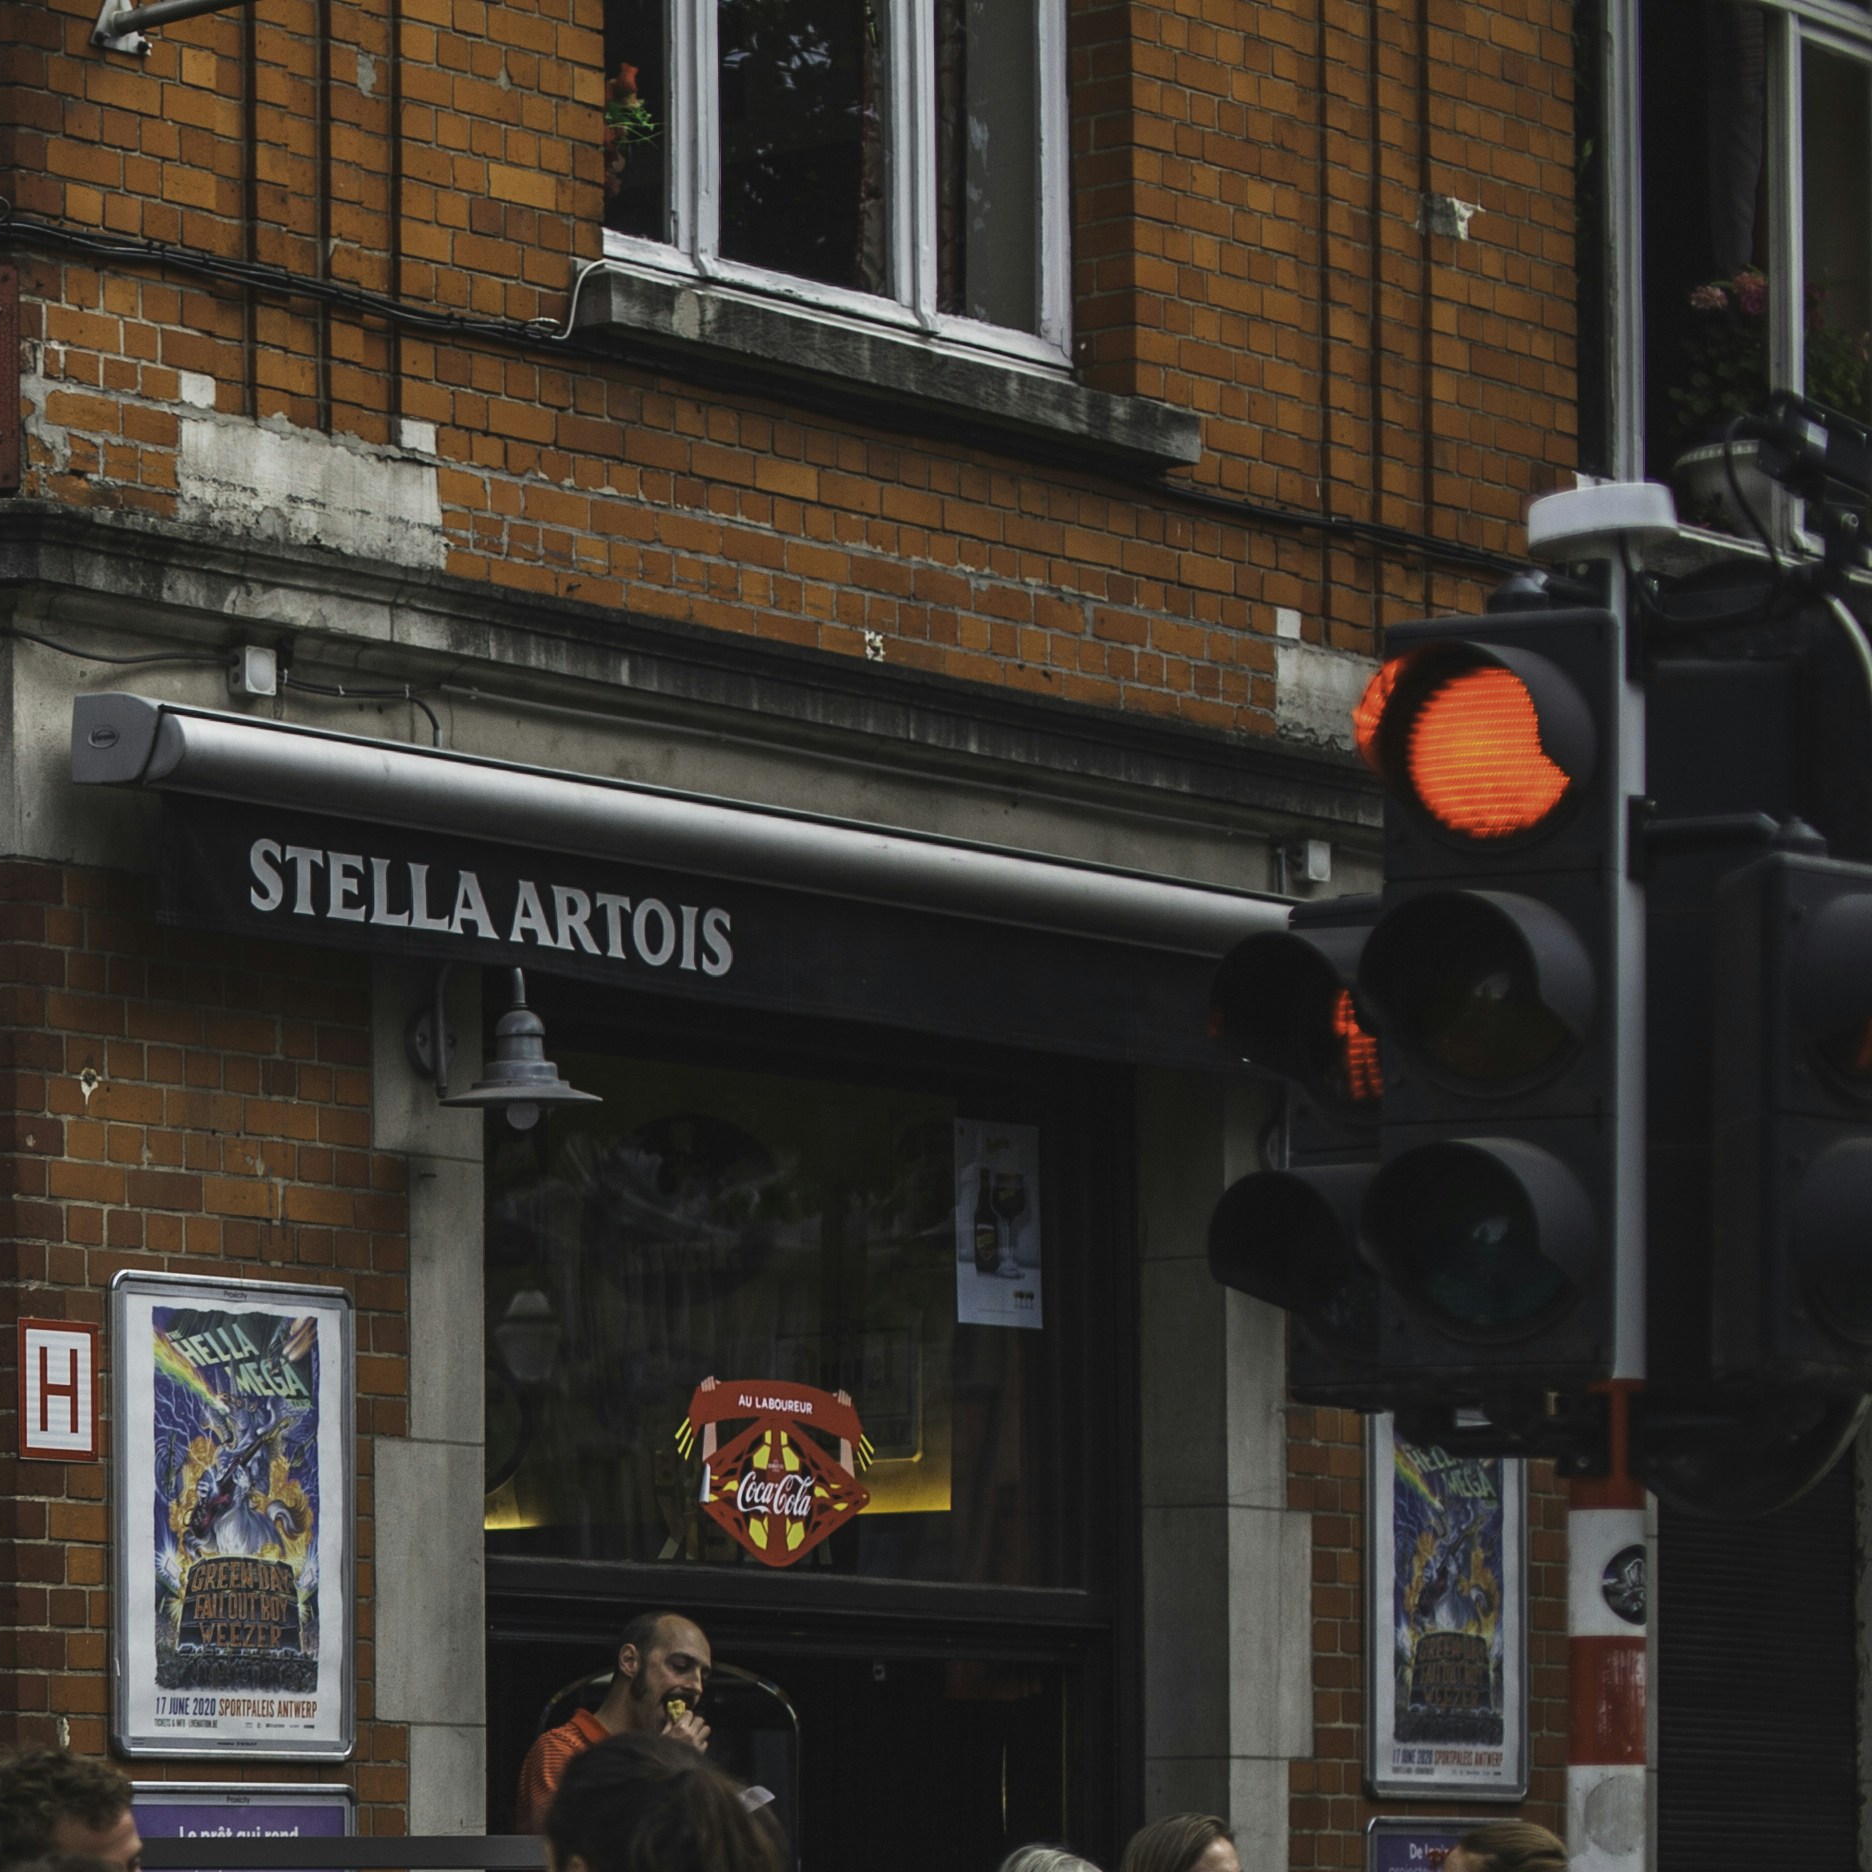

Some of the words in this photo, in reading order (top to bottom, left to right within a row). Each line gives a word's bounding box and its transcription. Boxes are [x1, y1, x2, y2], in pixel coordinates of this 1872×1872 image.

[249, 838, 500, 940] STELLA
[508, 879, 734, 978] ARTOIS
[171, 1323, 260, 1368] HELLA
[39, 1346, 78, 1433] H
[224, 1359, 310, 1397] MEGA
[738, 1394, 752, 1408] AU
[755, 1396, 813, 1415] LABOUREUR
[191, 1561, 253, 1592] GREEN
[258, 1563, 292, 1594] DAY
[228, 1592, 257, 1620] OUT
[260, 1595, 288, 1622] BOY
[199, 1622, 282, 1648] WEEZER
[156, 1697, 167, 1716] 17
[169, 1697, 190, 1715] JUNE
[193, 1697, 217, 1716] 2020
[219, 1697, 274, 1718] SPORTPALEIS
[277, 1700, 317, 1718] ANTWERP
[1409, 1843, 1423, 1860] De
